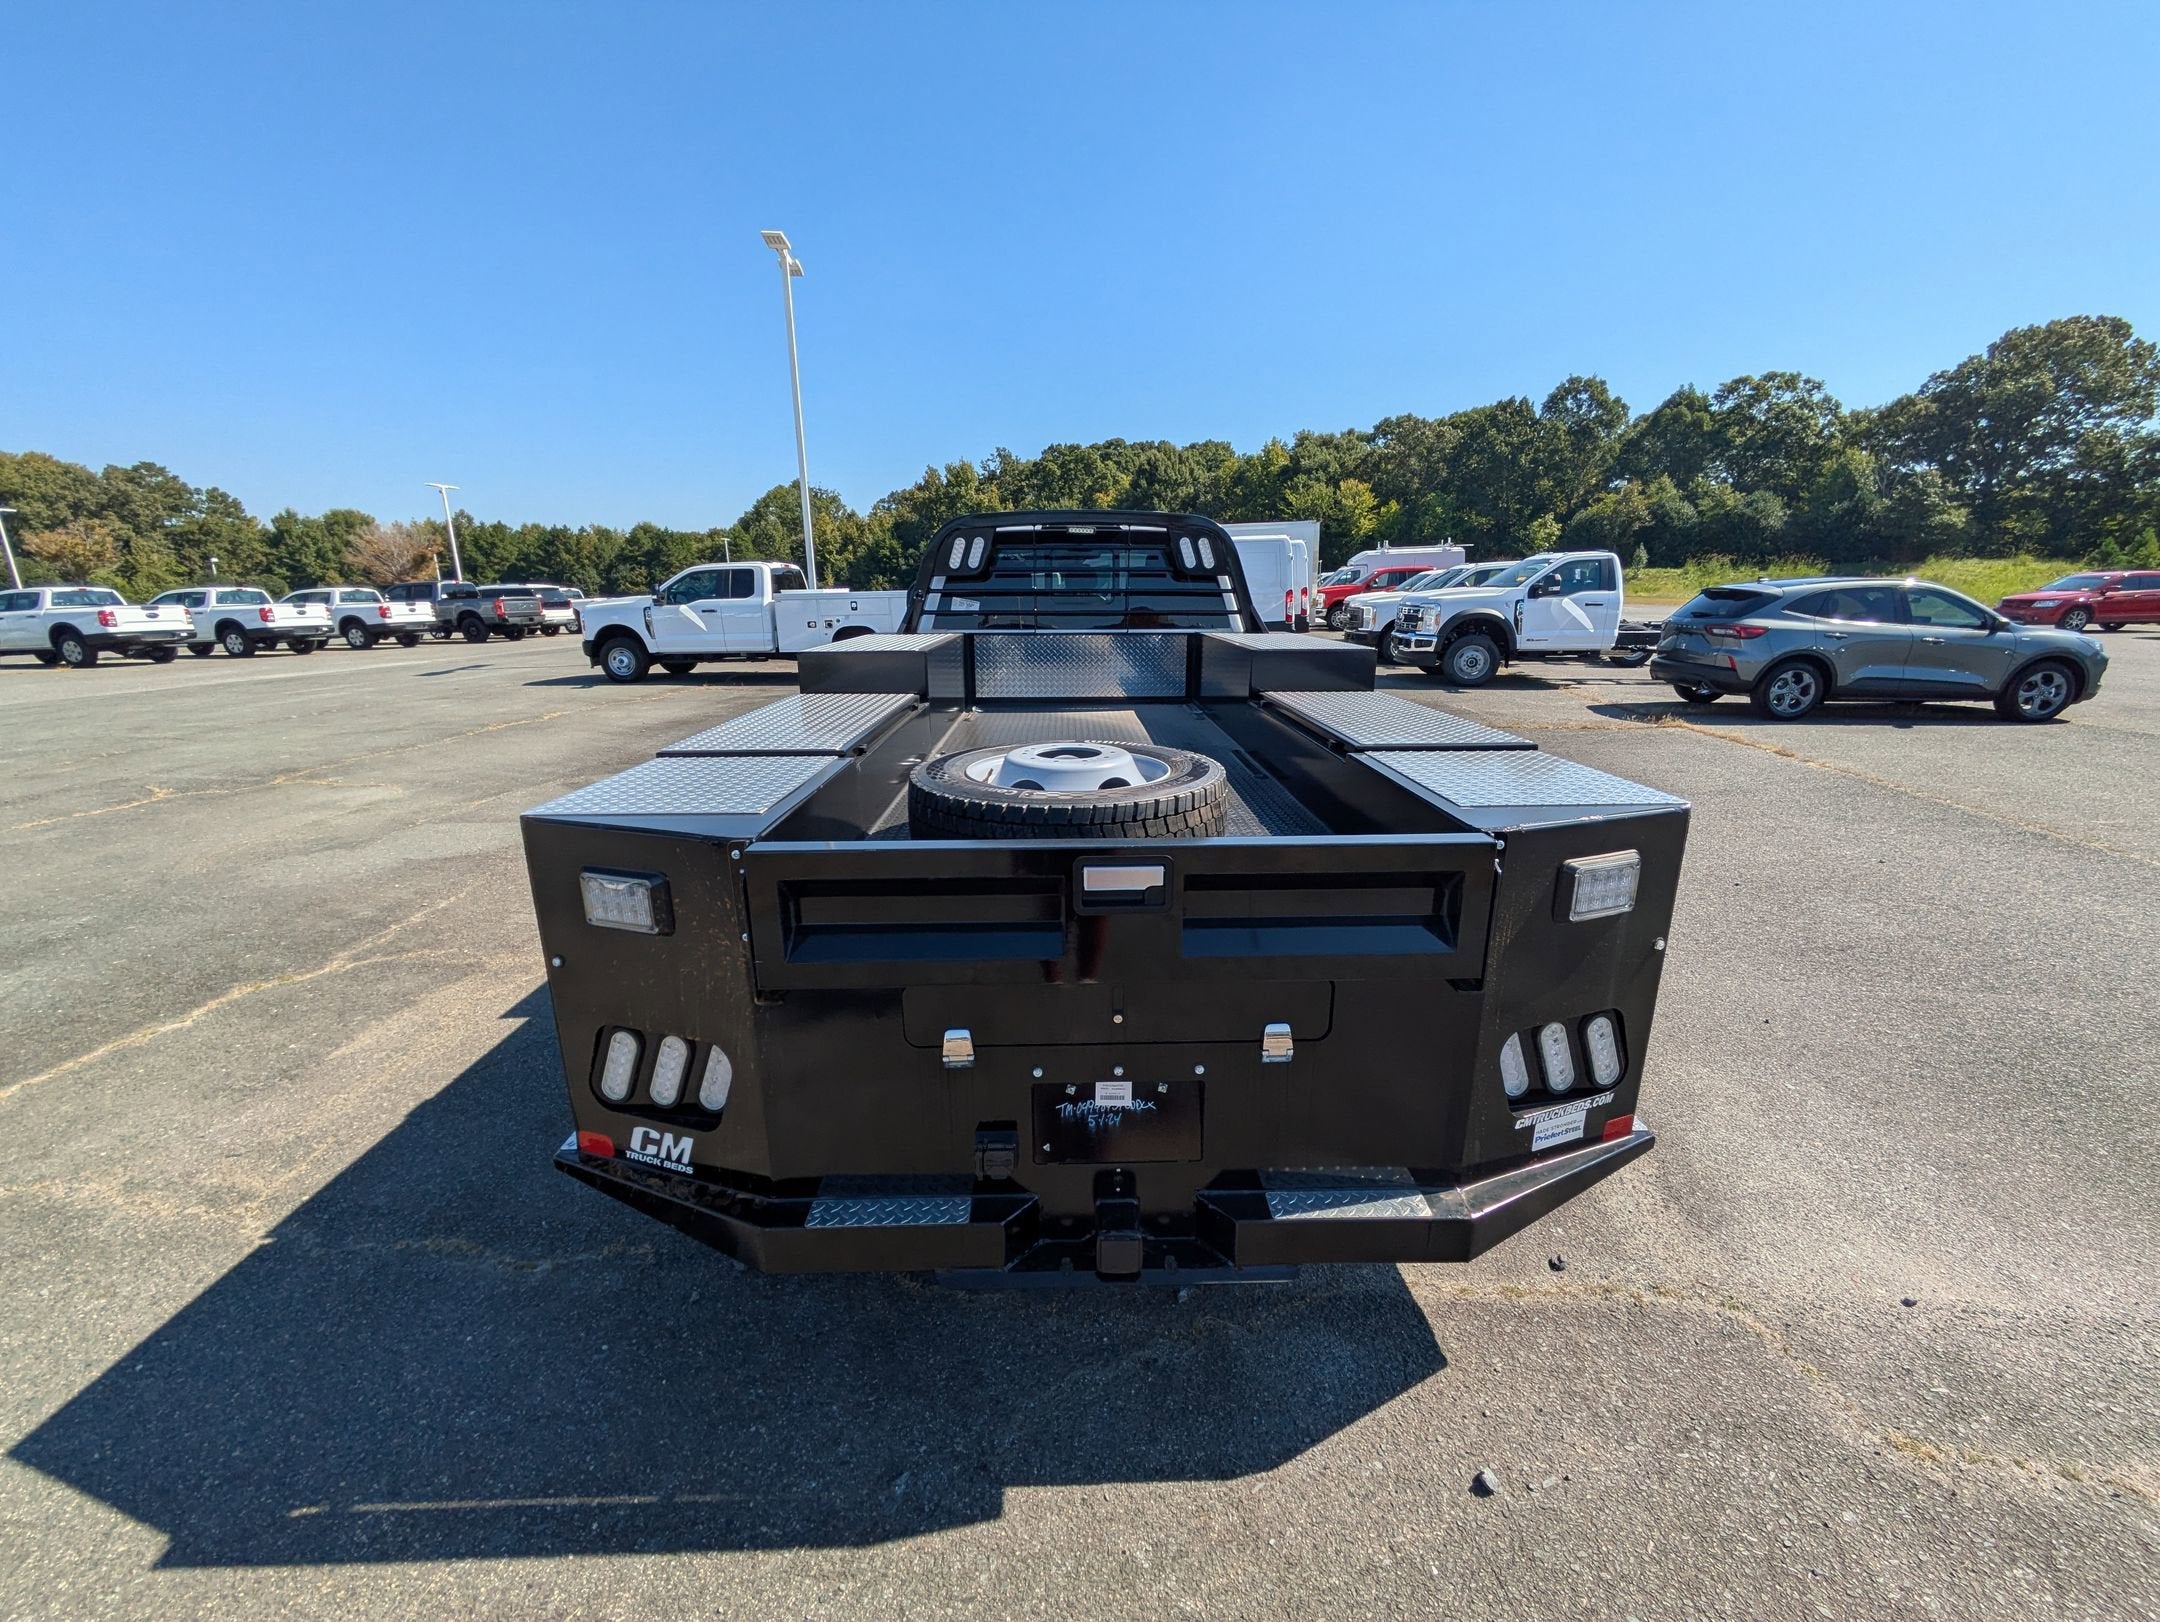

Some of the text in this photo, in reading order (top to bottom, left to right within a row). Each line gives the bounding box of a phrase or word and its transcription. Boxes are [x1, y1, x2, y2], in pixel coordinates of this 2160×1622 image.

[1515, 1093, 1615, 1129] CMTRUCKBEDS.COM
[625, 1150, 694, 1175] TRUCK BEDS
[630, 1126, 694, 1164] CM
